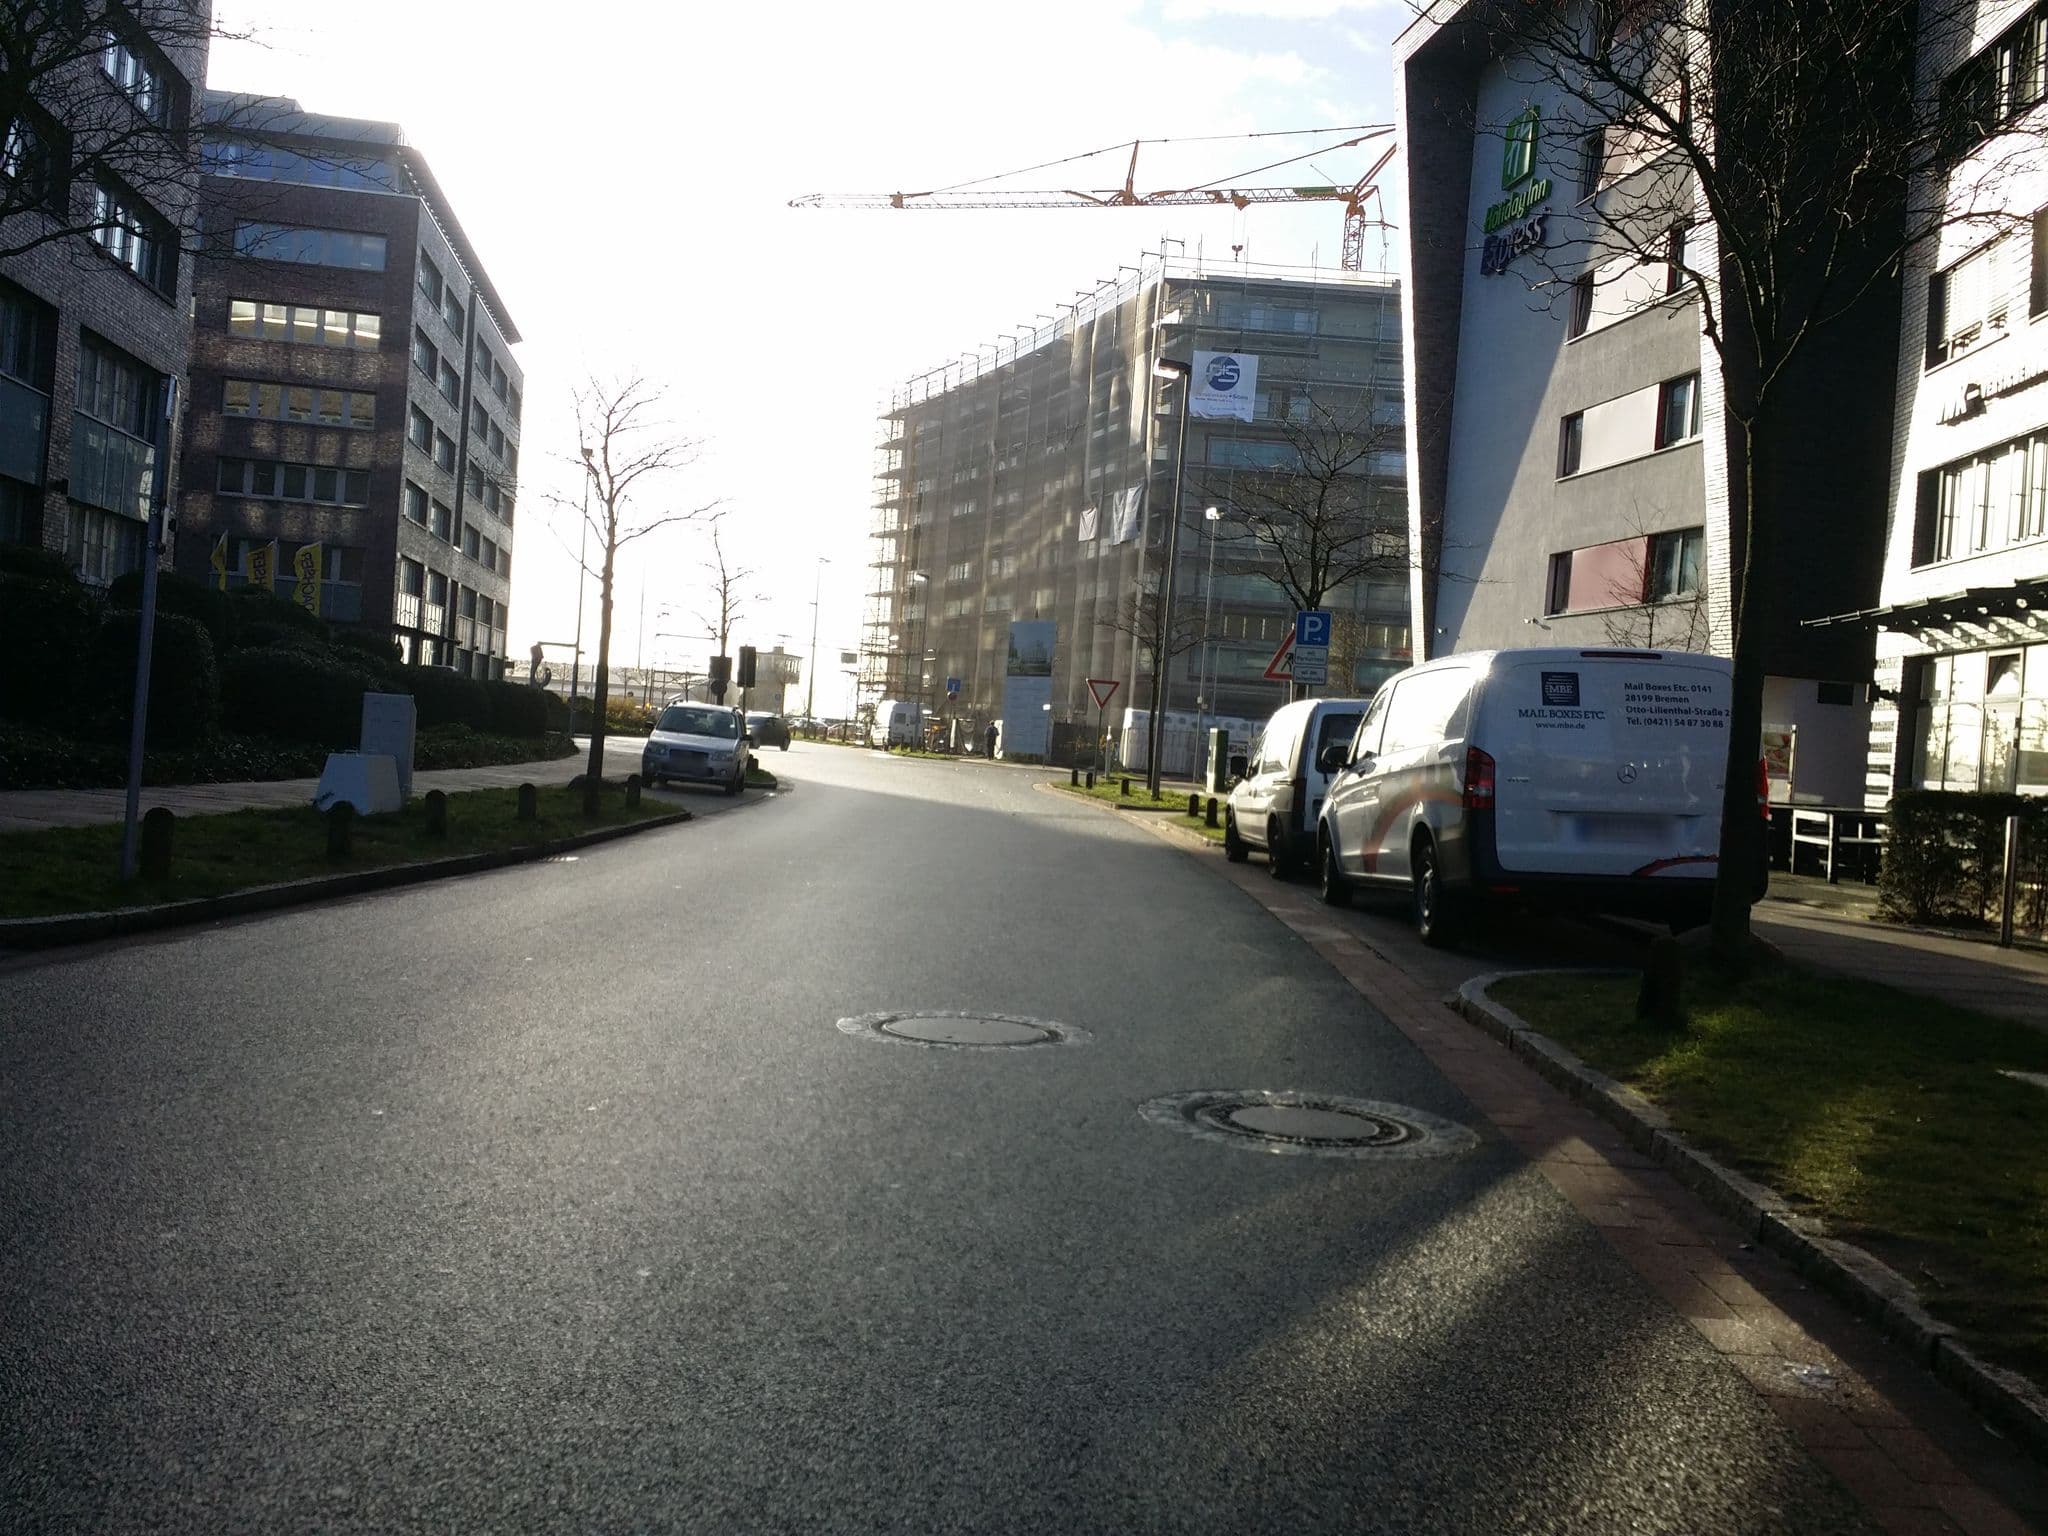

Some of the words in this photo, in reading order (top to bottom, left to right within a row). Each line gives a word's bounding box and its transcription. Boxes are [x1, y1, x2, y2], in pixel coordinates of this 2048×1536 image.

[1485, 191, 1527, 232] Holiday
[1526, 177, 1548, 206] Inn
[1304, 616, 1323, 642] P
[1549, 685, 1573, 694] MBE
[1624, 683, 1644, 691] Mail
[1645, 683, 1672, 692] Boxes
[1673, 684, 1690, 692] Etc.
[1691, 685, 1712, 693] 0141
[1625, 694, 1653, 702] 28199
[1655, 695, 1690, 703] Bremen
[1518, 709, 1547, 718] MAIL
[1549, 710, 1583, 719] BOXES
[1584, 711, 1605, 720] ETC.
[1626, 706, 1723, 717] Otto-Lilienthal-Straße
[1535, 721, 1586, 730] www.mbe.de
[1626, 717, 1642, 725] Tel.
[1644, 718, 1673, 727] (0421)
[1674, 718, 1685, 727] 54
